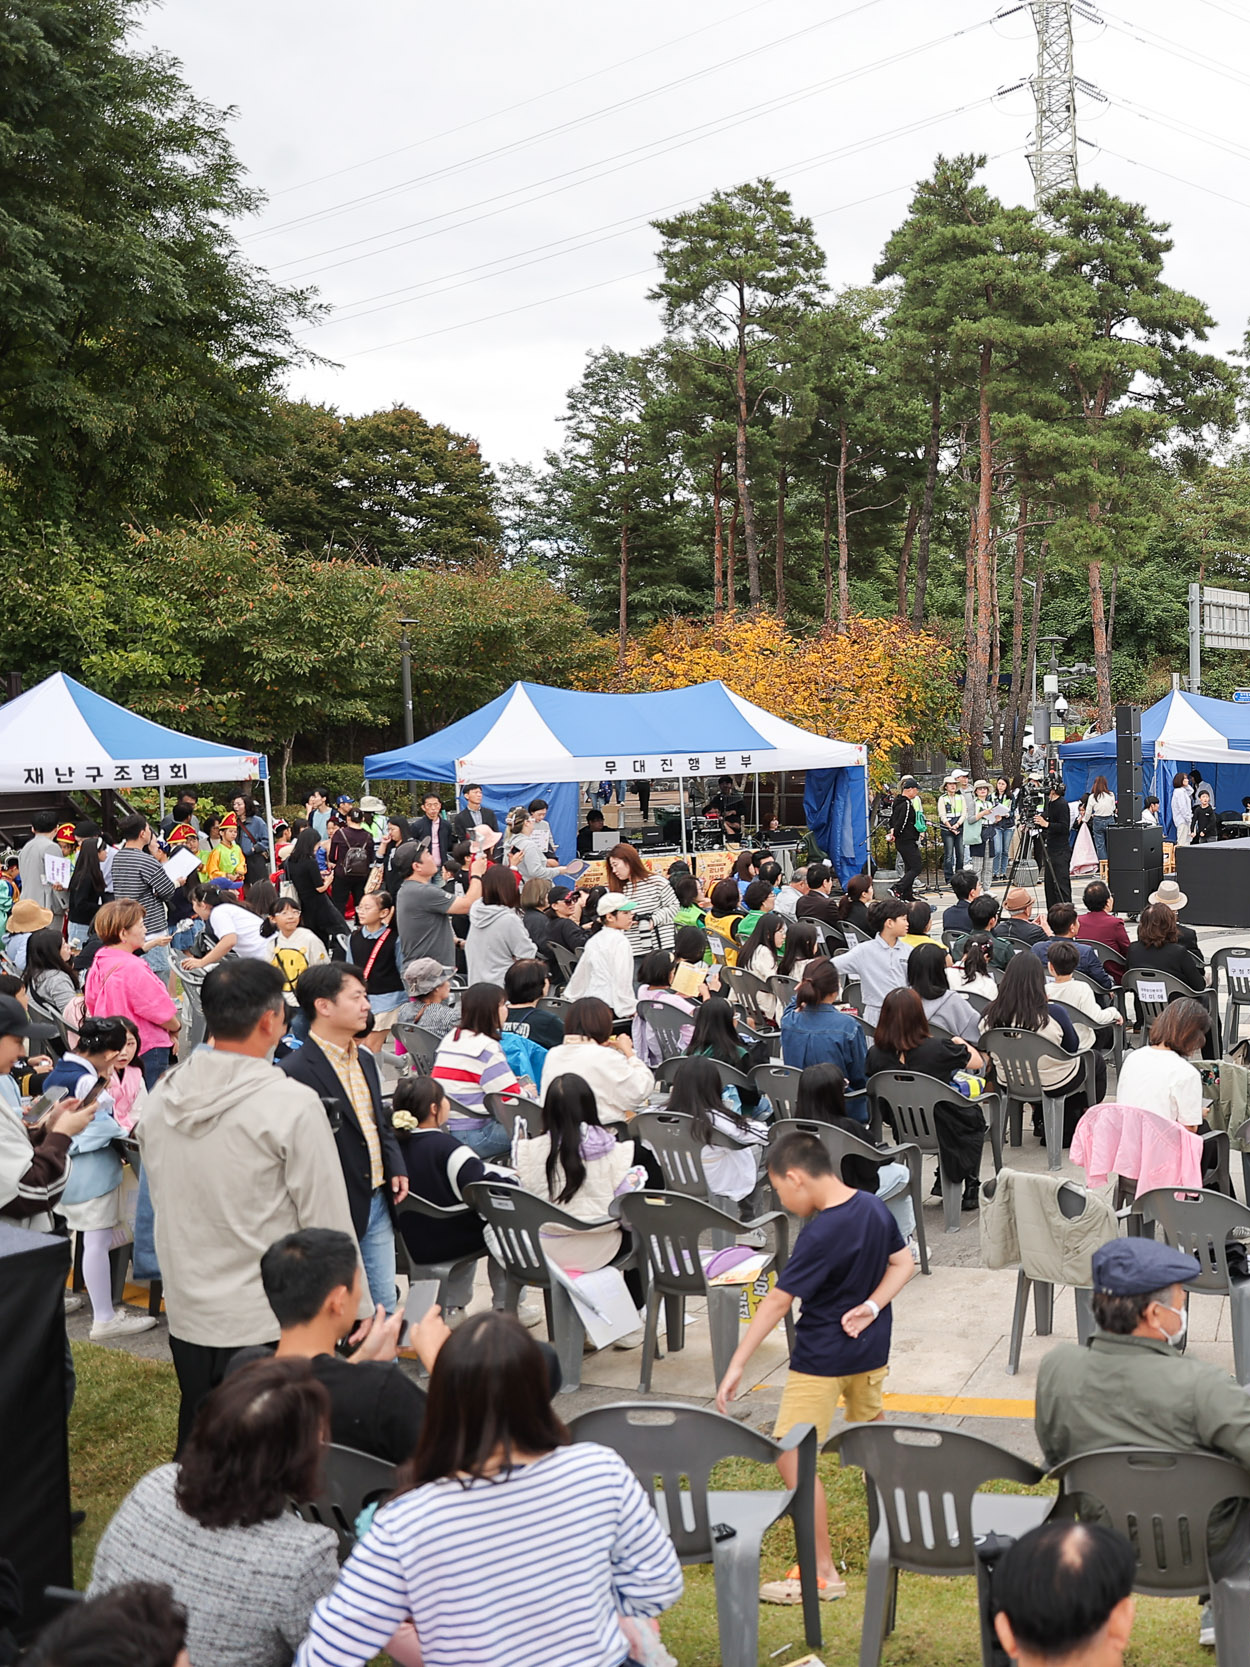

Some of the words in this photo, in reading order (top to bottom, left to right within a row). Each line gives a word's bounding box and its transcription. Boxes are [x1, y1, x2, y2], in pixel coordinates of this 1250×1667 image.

[24, 763, 188, 785] 재난구조협회
[604, 755, 752, 775] 무대진행본부
[230, 853, 237, 866] 5
